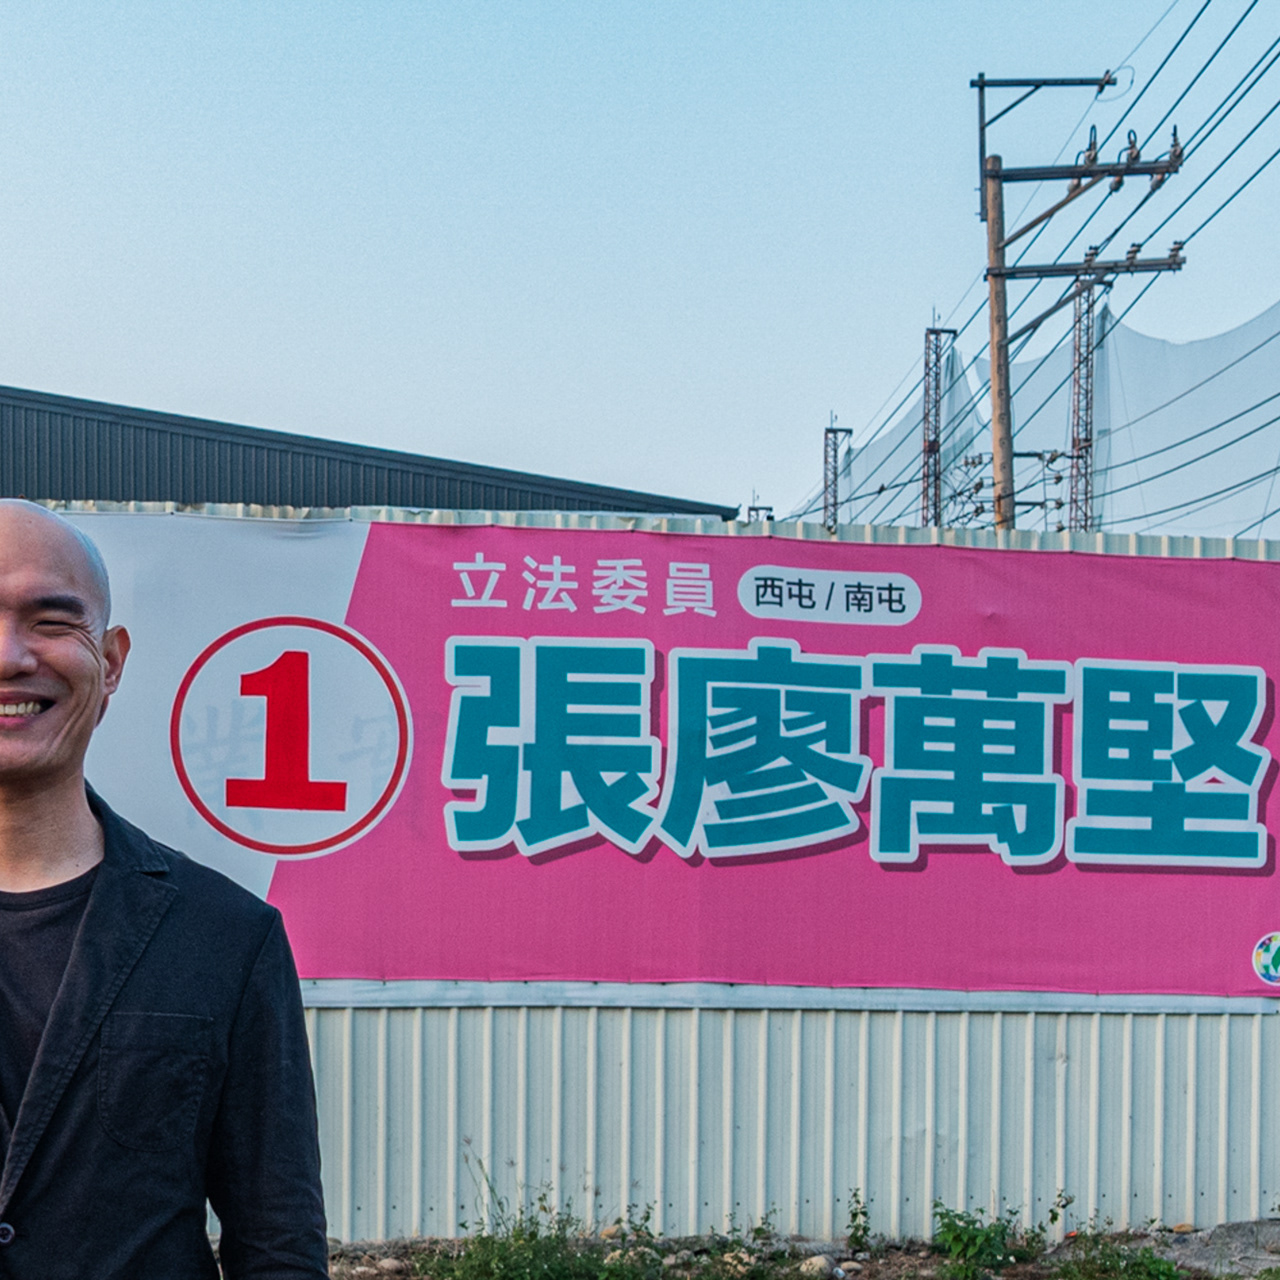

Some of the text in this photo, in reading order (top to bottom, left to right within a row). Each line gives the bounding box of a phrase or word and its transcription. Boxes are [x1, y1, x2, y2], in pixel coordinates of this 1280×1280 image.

[451, 552, 717, 617] 立法委員
[225, 650, 347, 811] 1
[442, 635, 1271, 868] 張廖萬堅
